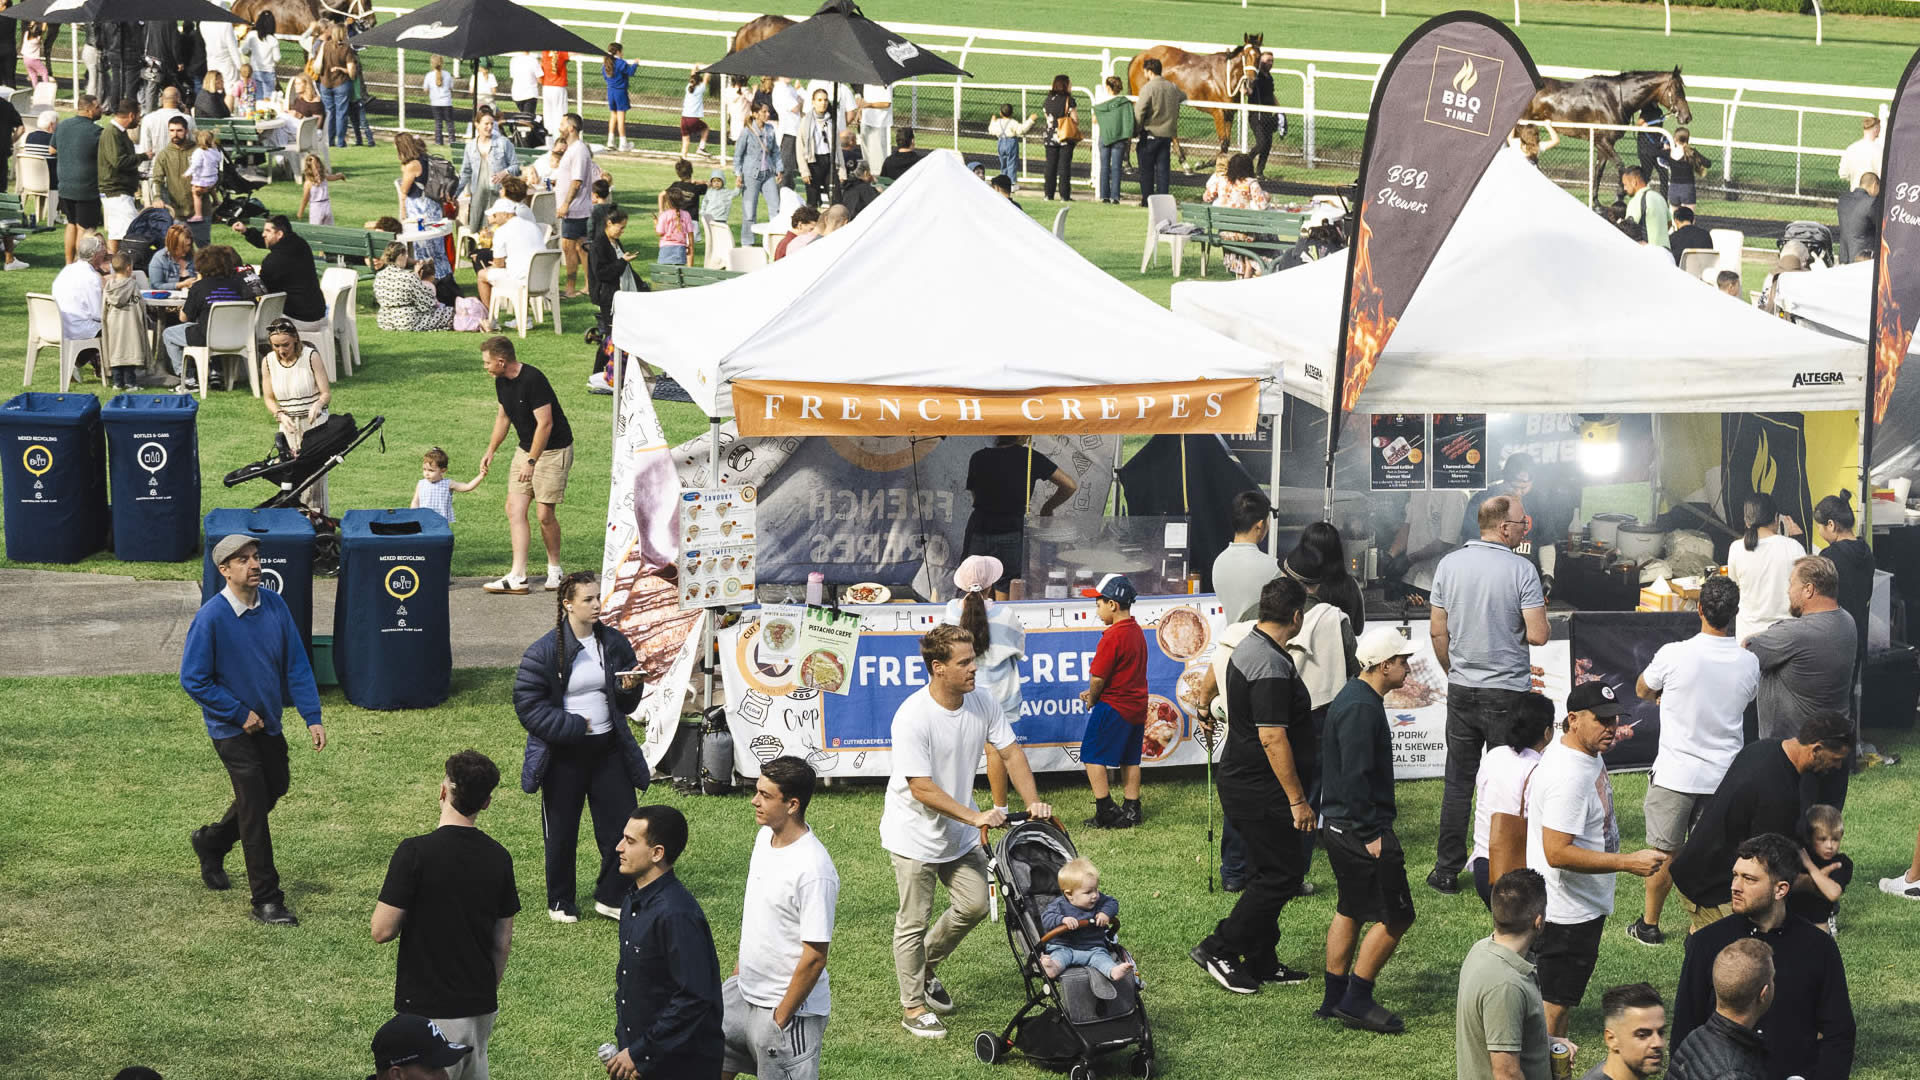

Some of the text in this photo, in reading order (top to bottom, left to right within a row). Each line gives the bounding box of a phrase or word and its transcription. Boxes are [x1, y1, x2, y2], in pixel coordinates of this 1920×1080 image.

[1442, 89, 1482, 114] BBQ
[1444, 107, 1476, 123] TIME
[1387, 164, 1429, 190] BBQ
[1376, 187, 1429, 214] Skewers
[1895, 182, 1920, 203] BB
[1792, 371, 1844, 388] ALTEGRA
[763, 391, 1223, 422] FRENCH CREPES
[704, 493, 732, 502] SAVOURY
[711, 548, 731, 556] SWEET
[743, 625, 756, 639] CUT
[808, 624, 834, 635] PISTACHIO
[859, 656, 926, 686] FRE
[1020, 699, 1093, 716] AVOUR
[1398, 731, 1428, 739] PORK/
[1404, 743, 1444, 751] SKEWER
[1392, 754, 1426, 762] EAL $18
